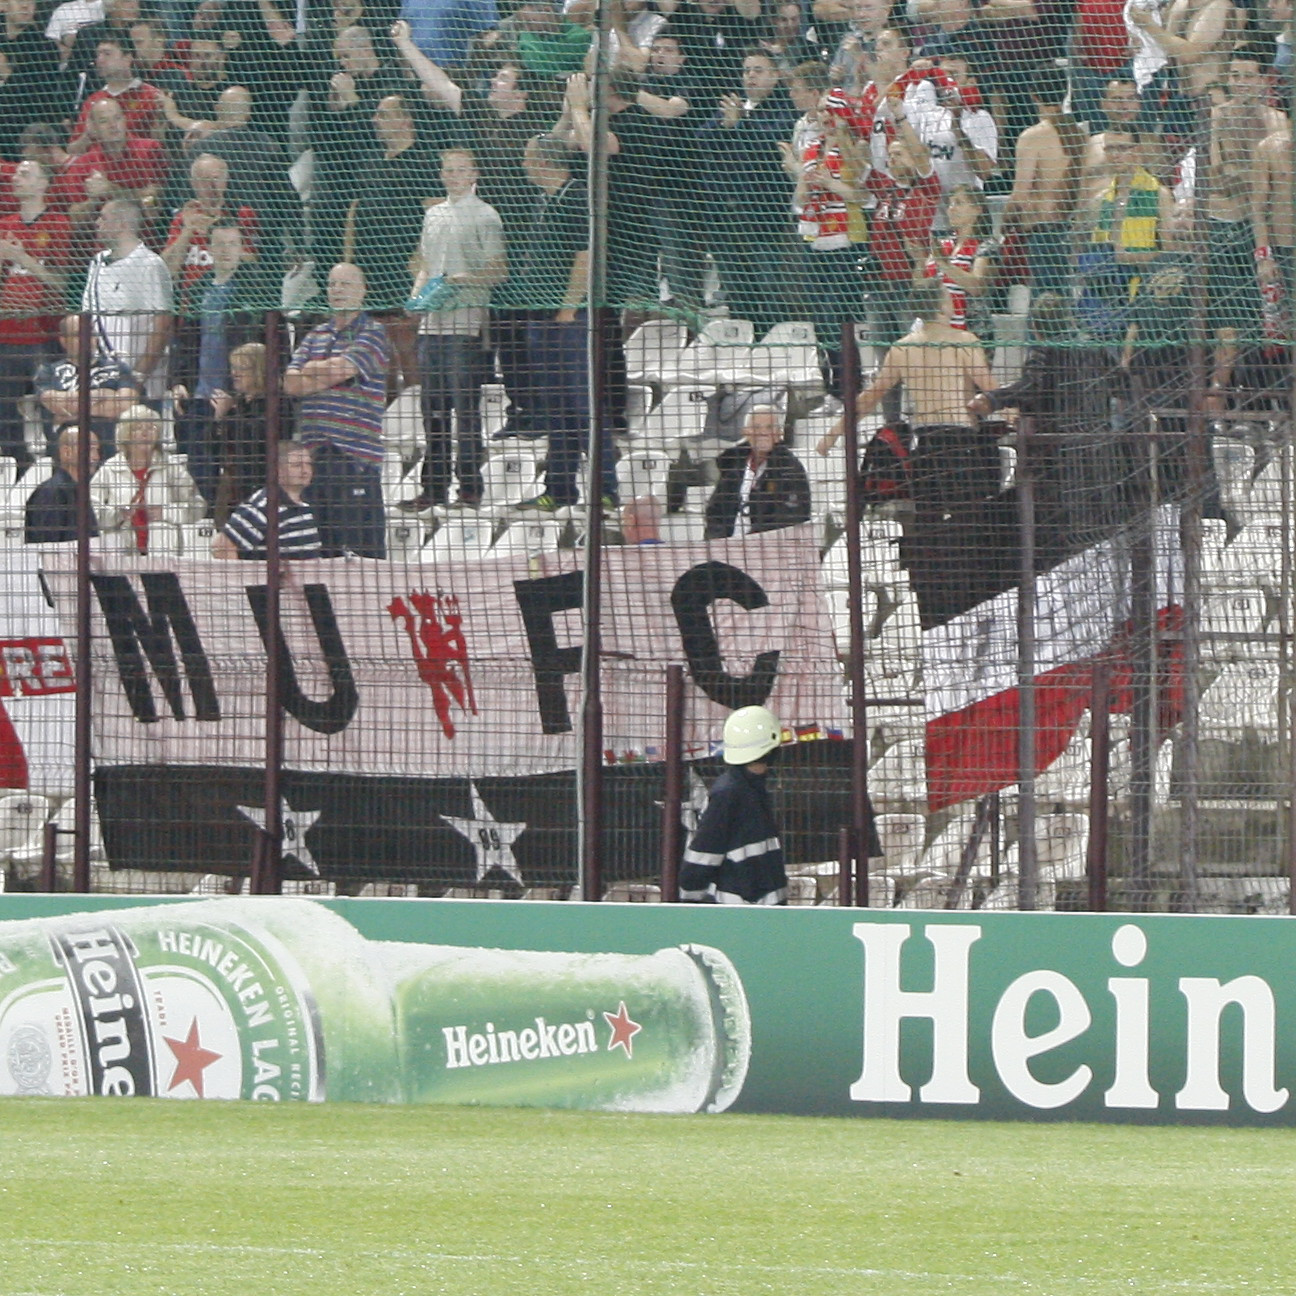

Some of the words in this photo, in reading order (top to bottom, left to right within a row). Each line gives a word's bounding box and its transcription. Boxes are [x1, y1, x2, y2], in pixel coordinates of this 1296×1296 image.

[157, 930, 275, 1028] HEINEKEN
[274, 986, 302, 1055] ORIGINAL
[442, 1016, 599, 1069] Heineken
